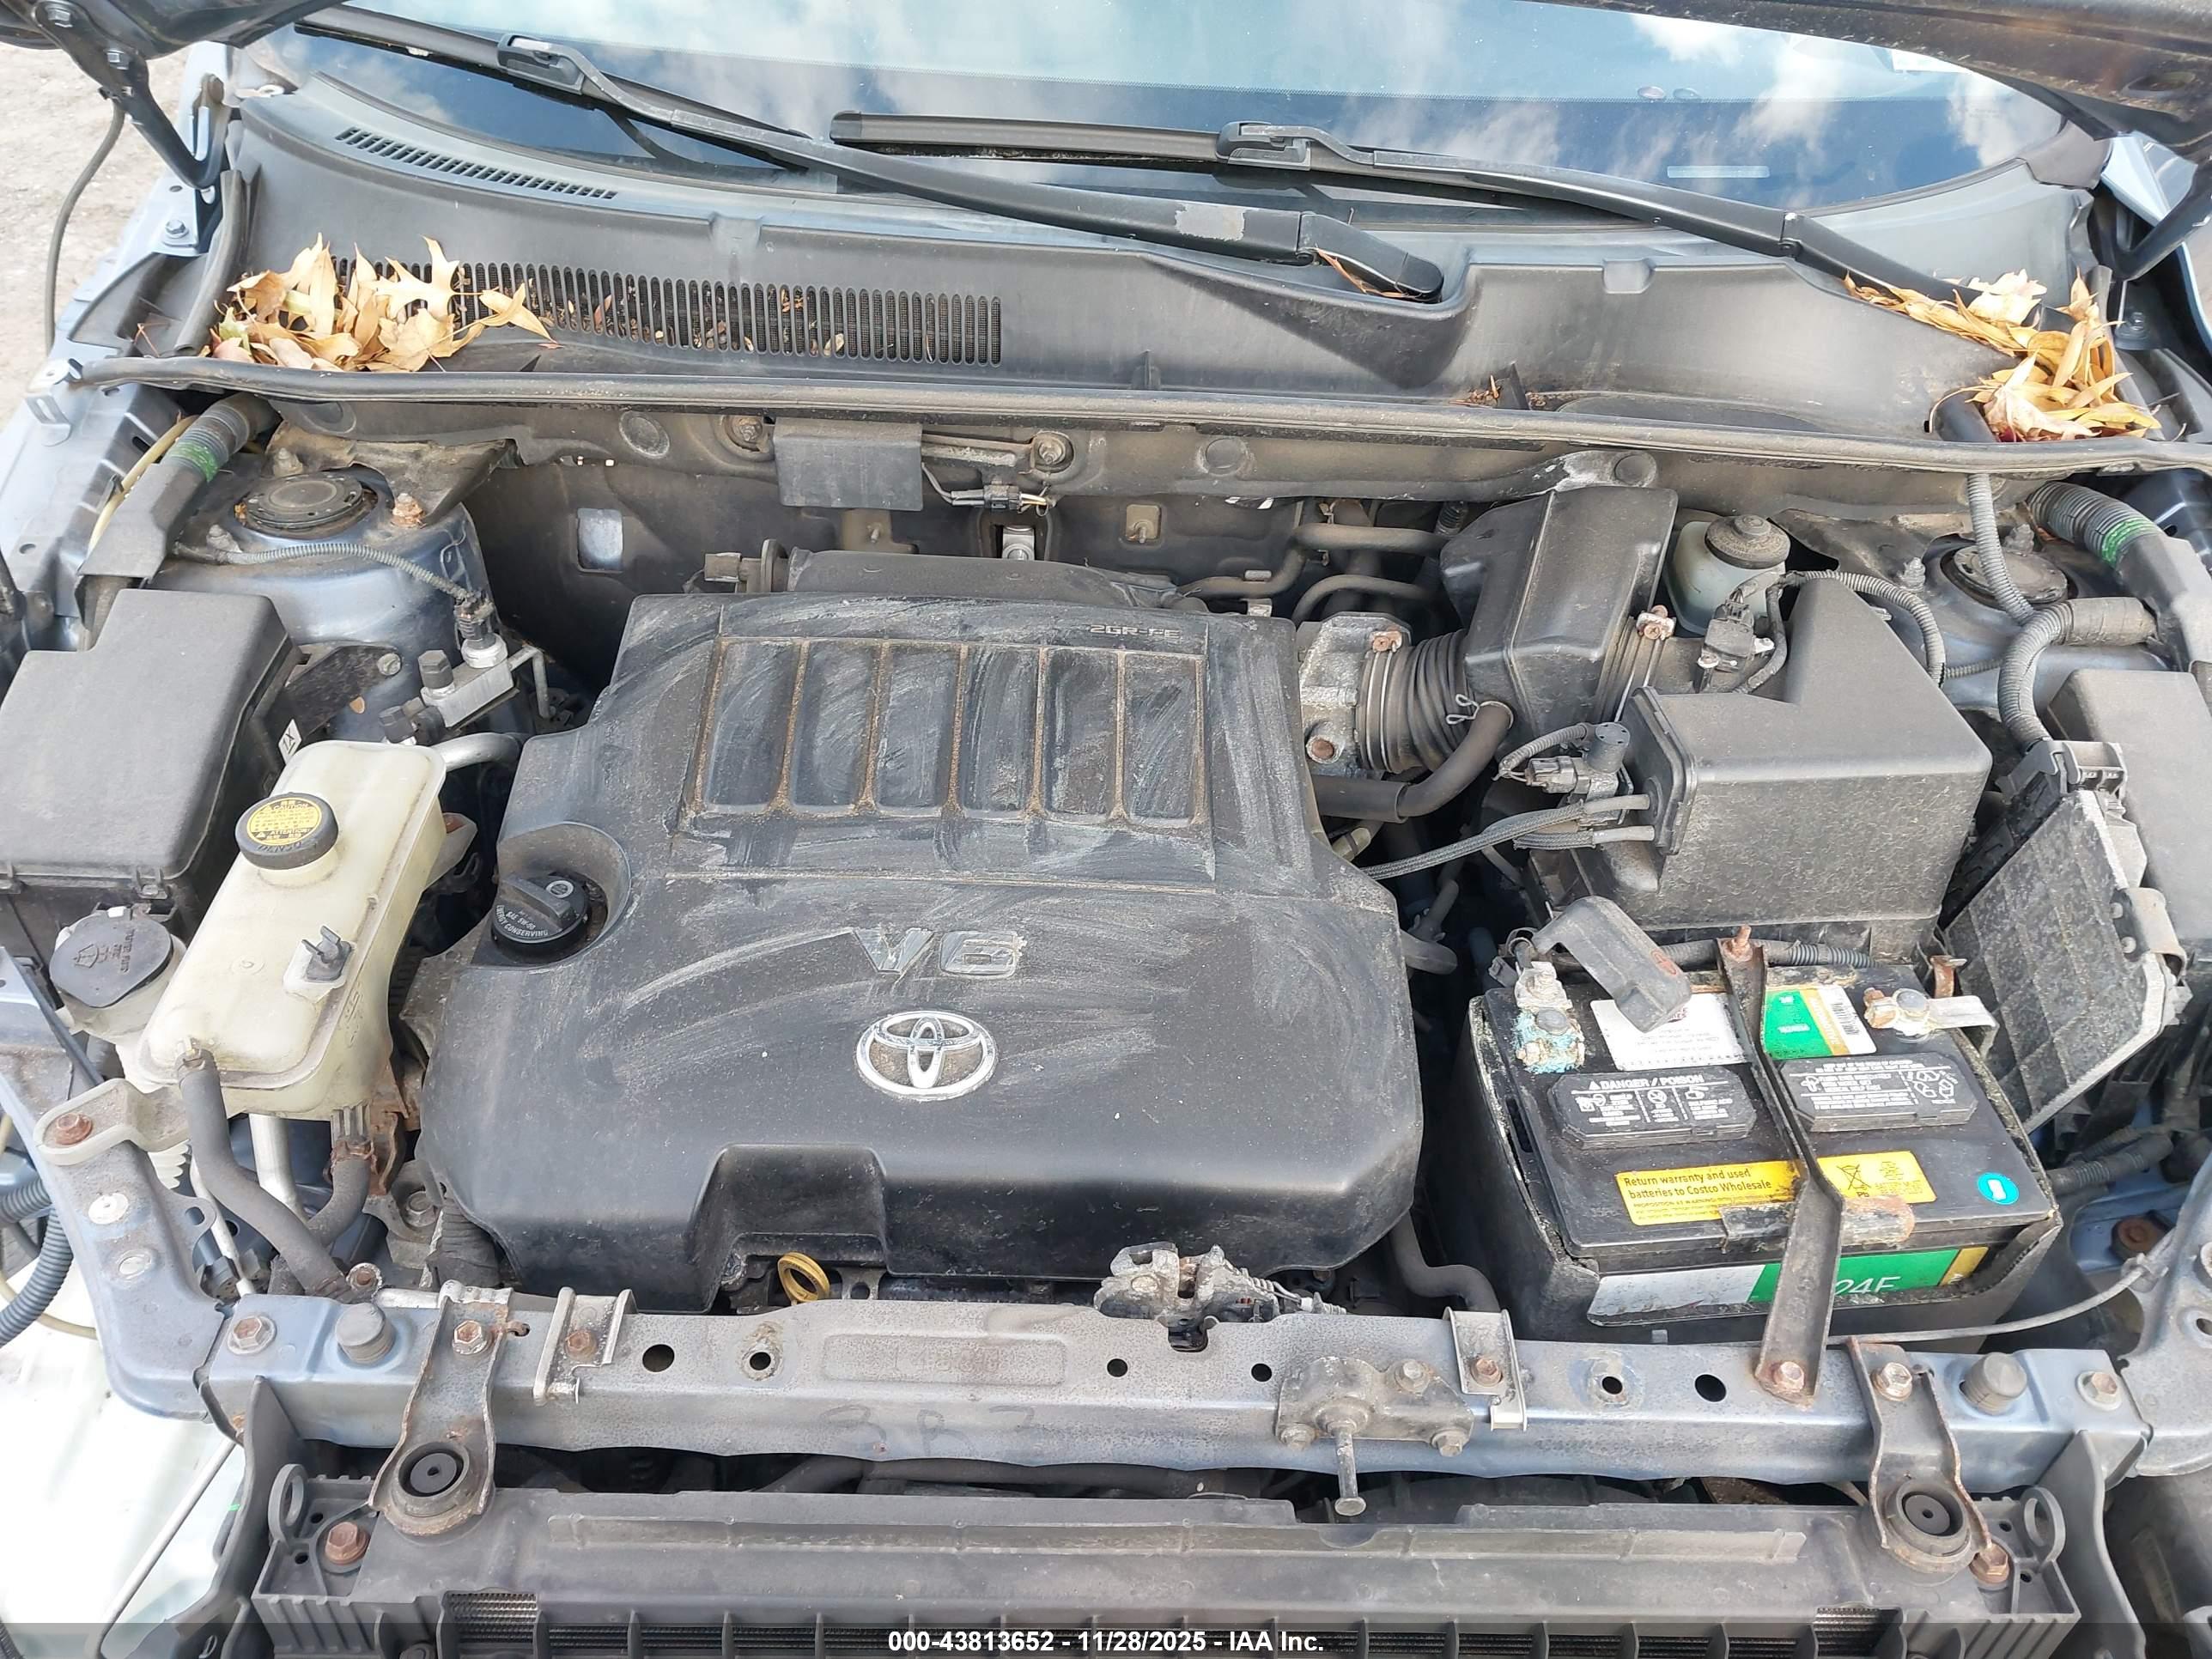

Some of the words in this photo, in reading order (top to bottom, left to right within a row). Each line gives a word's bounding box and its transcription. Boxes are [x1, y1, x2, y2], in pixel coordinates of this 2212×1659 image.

[1090, 624, 1182, 638] 2GR-FE
[504, 923, 549, 938] CONSERVING
[854, 927, 1020, 978] V6
[1600, 1078, 1650, 1090] DANGER
[1662, 1074, 1705, 1085] POISON
[1624, 1176, 1658, 1187] Return
[1660, 1172, 1704, 1184] warranty
[1706, 1170, 1724, 1181] and
[1728, 1168, 1751, 1178] used
[1629, 1187, 1674, 1199] batteries
[1674, 1186, 1685, 1196] to
[1686, 1183, 1718, 1195] Costco
[1720, 1180, 1772, 1193] Wholesale
[1856, 1190, 1870, 1199] Pb
